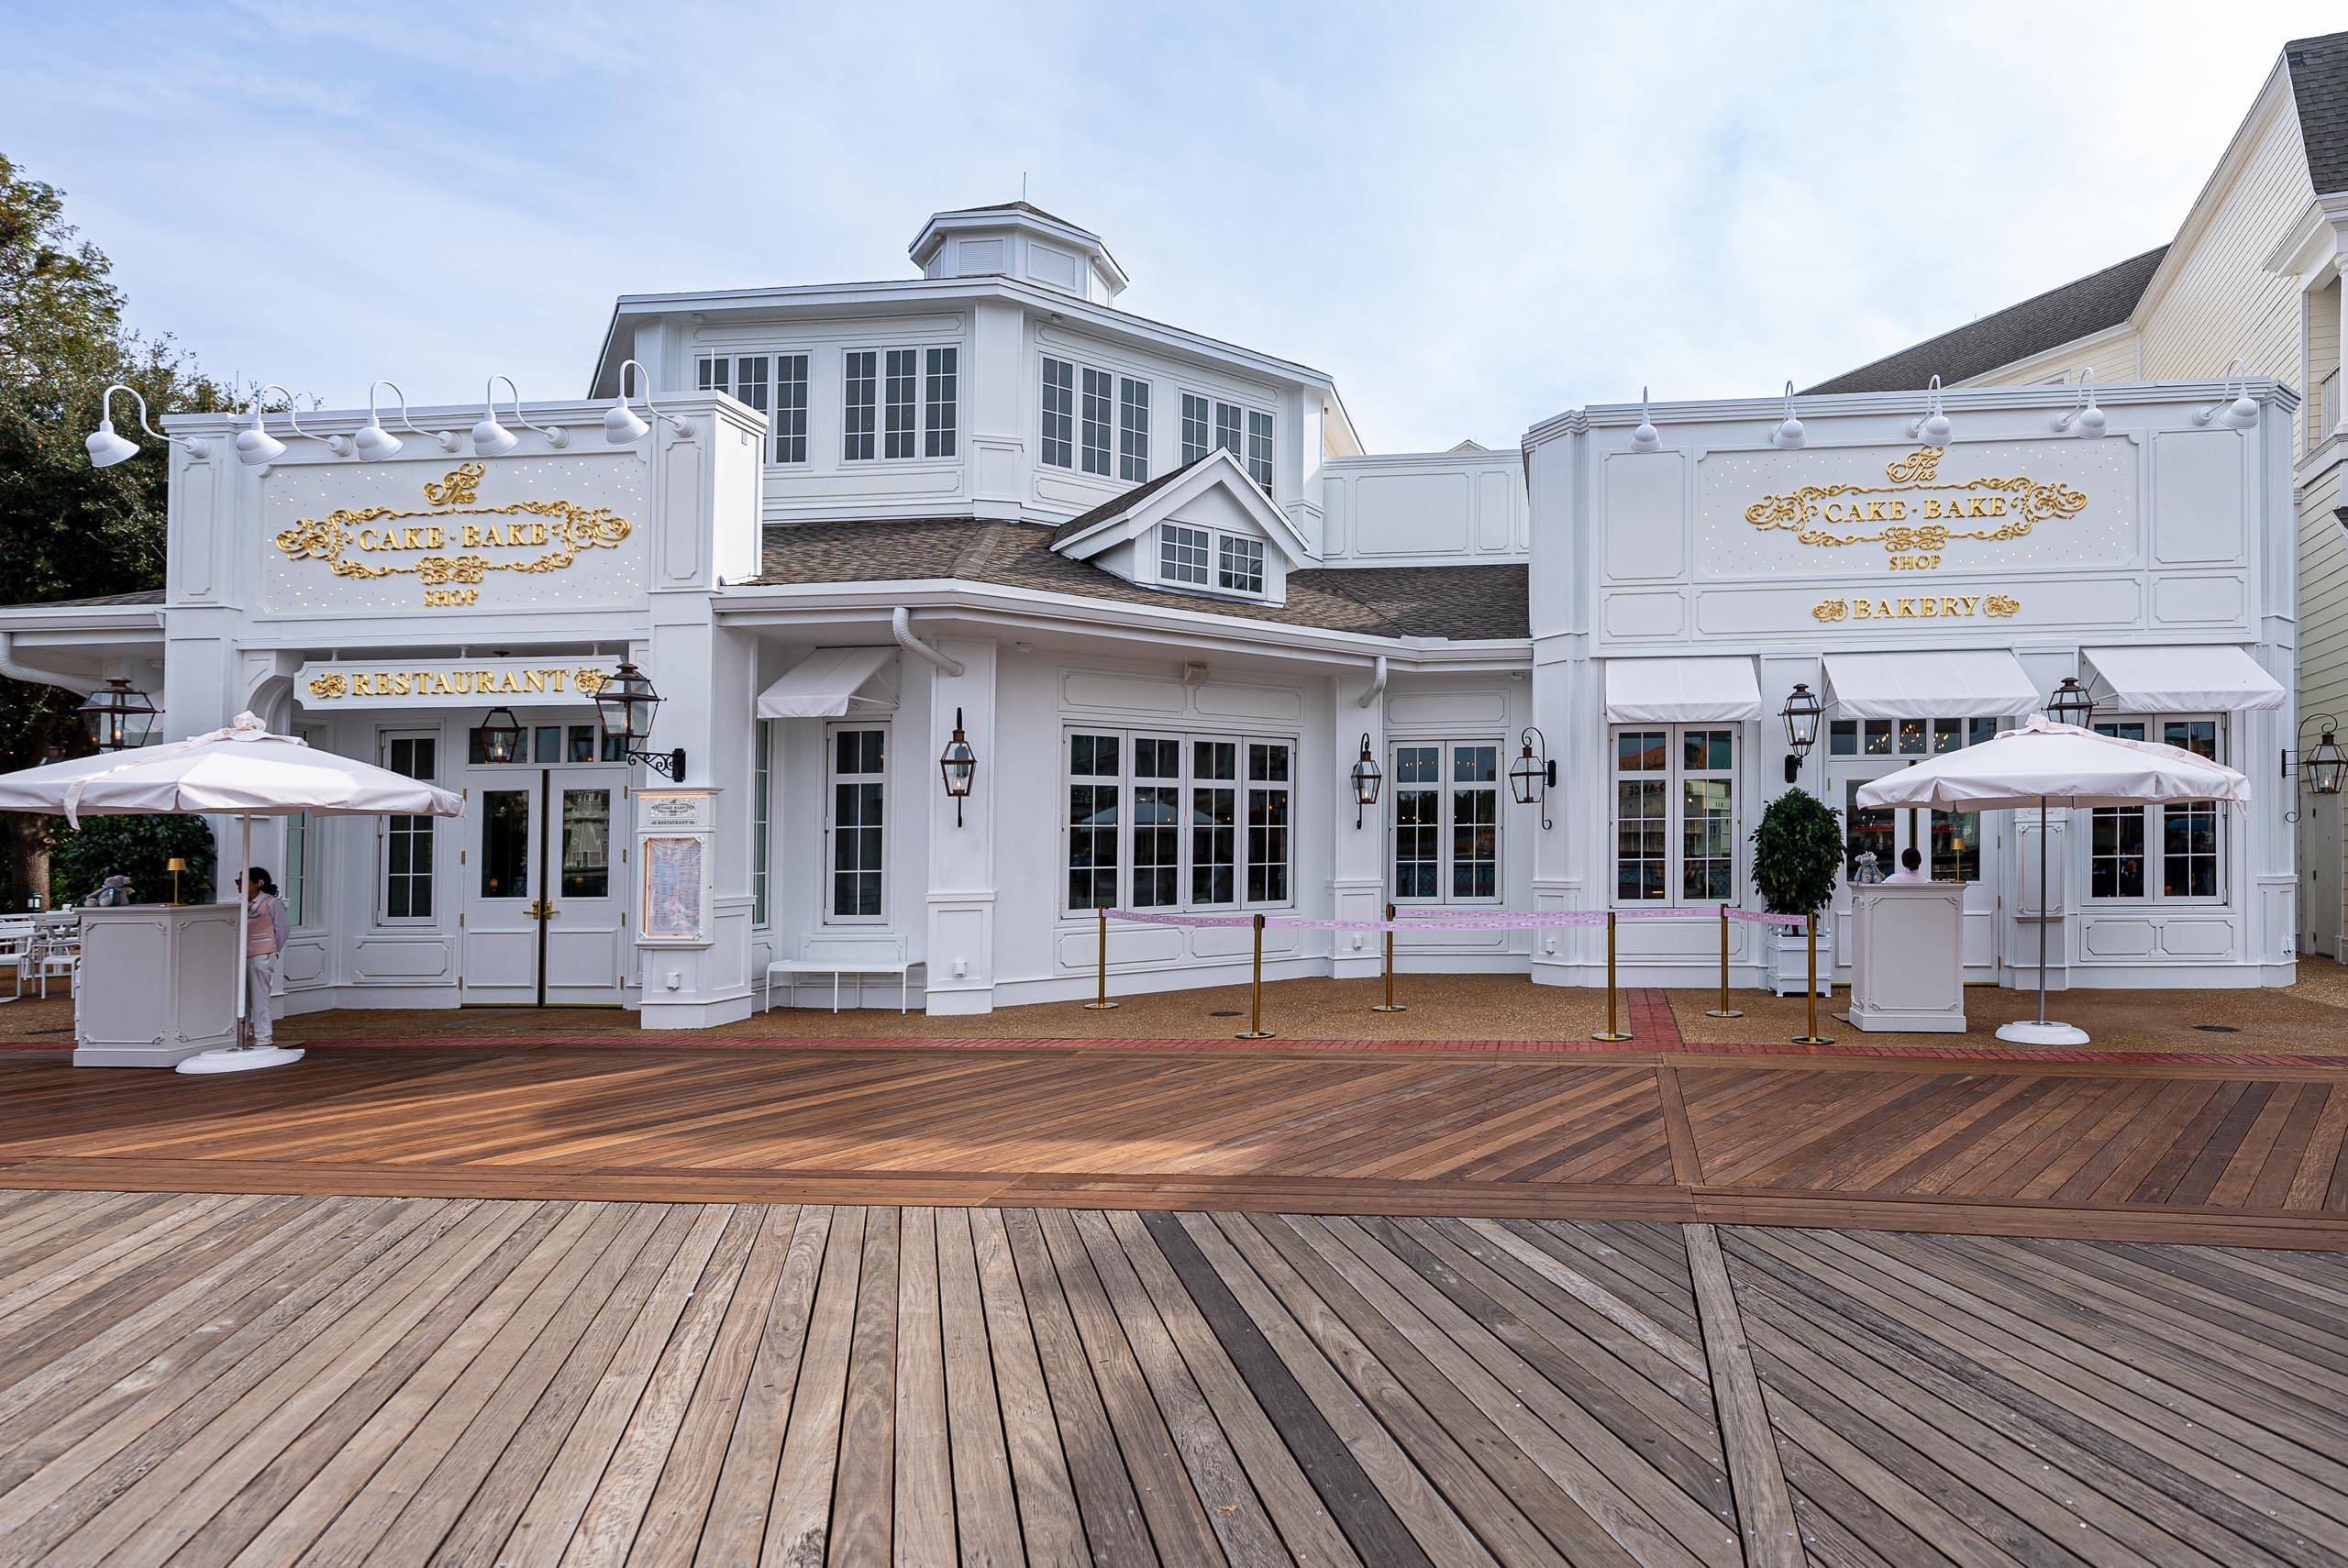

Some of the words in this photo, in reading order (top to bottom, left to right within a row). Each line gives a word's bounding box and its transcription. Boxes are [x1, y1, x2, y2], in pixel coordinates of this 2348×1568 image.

[1886, 447, 1944, 483] The
[424, 462, 484, 505] The
[1824, 501, 1908, 525] CAKE
[1924, 497, 2008, 519] BAKE
[359, 527, 446, 552] CAKE
[461, 524, 548, 547] BAKE
[1889, 555, 1942, 570] SHOP
[423, 589, 479, 607] SHOP
[1853, 596, 1980, 619] BAKERY
[352, 669, 570, 696] RESTAURANT
